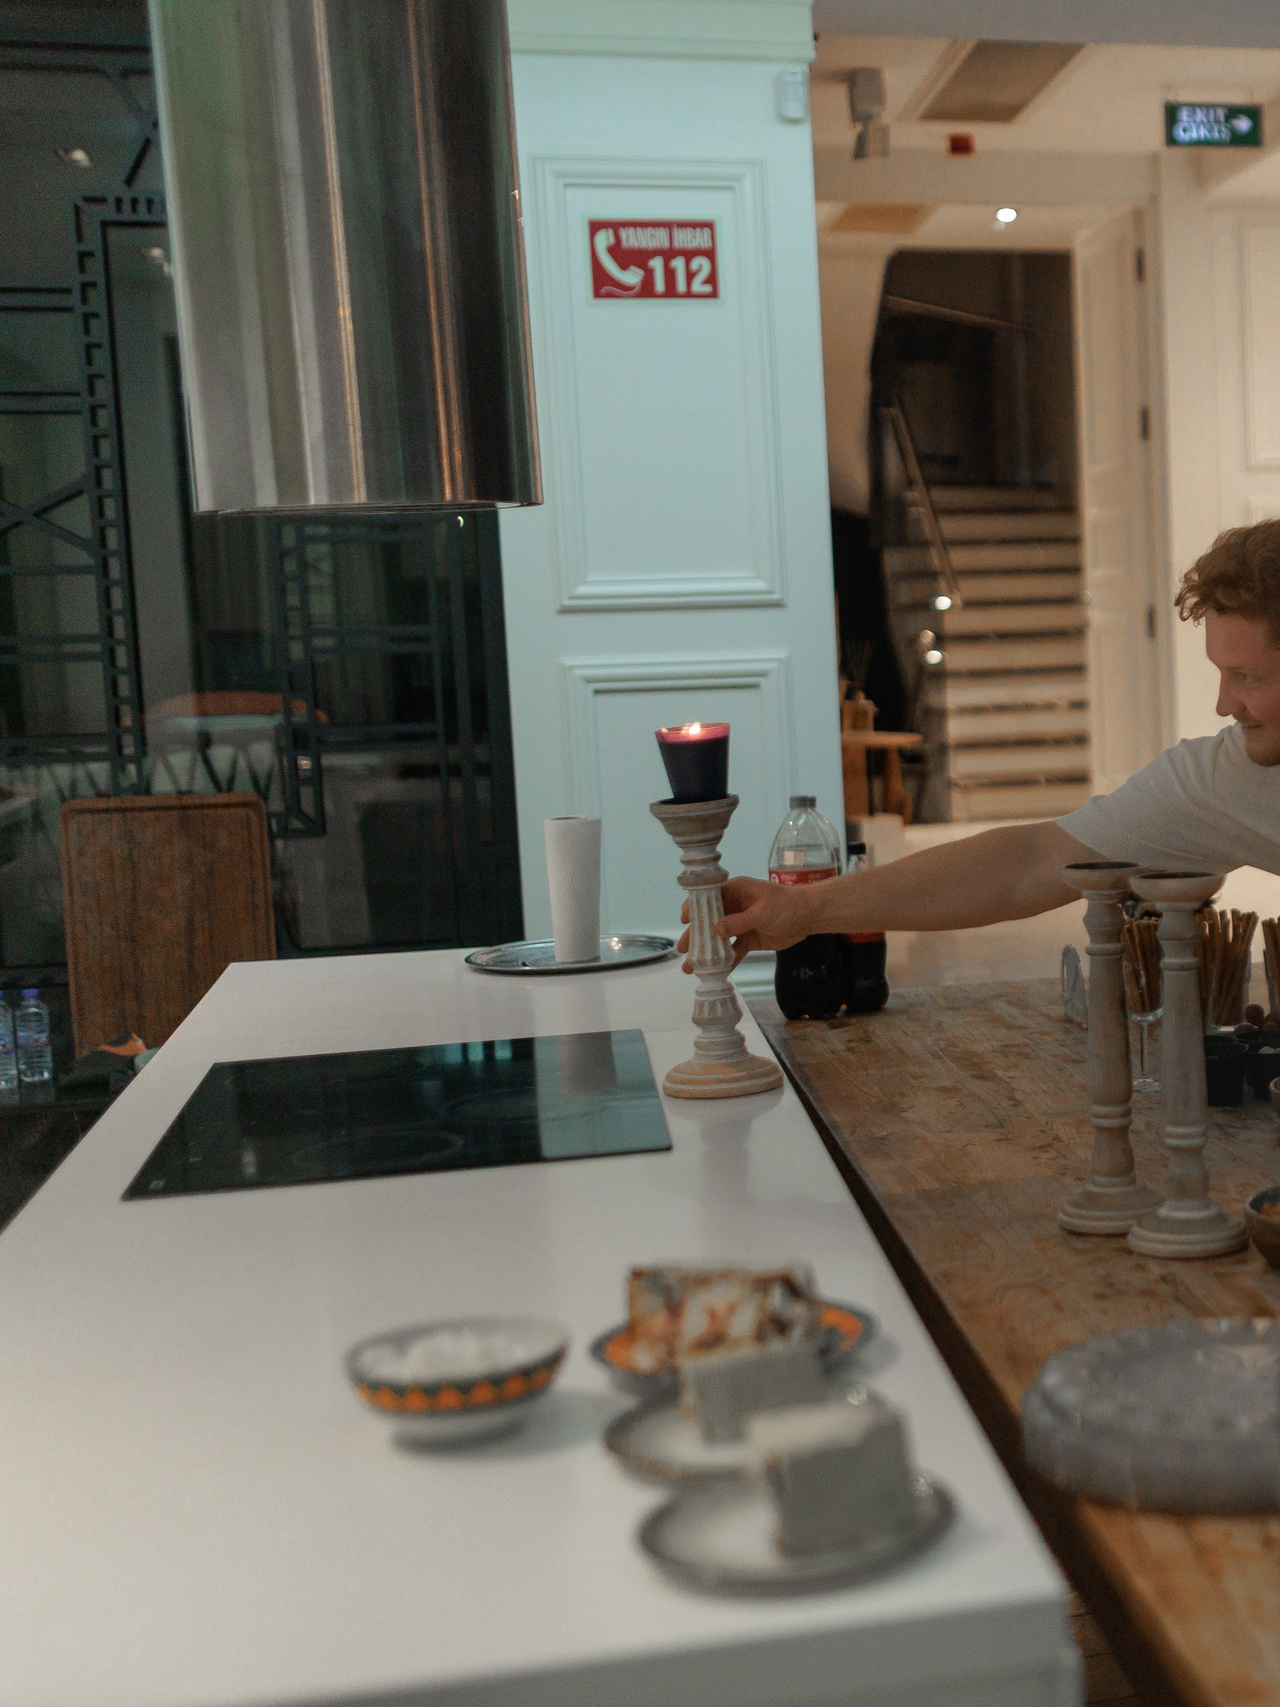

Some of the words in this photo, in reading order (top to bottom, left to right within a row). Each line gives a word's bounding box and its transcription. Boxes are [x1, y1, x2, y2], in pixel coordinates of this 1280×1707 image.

[1177, 106, 1228, 122] EXIT
[618, 226, 670, 249] YANGIN
[647, 255, 713, 294] 112
